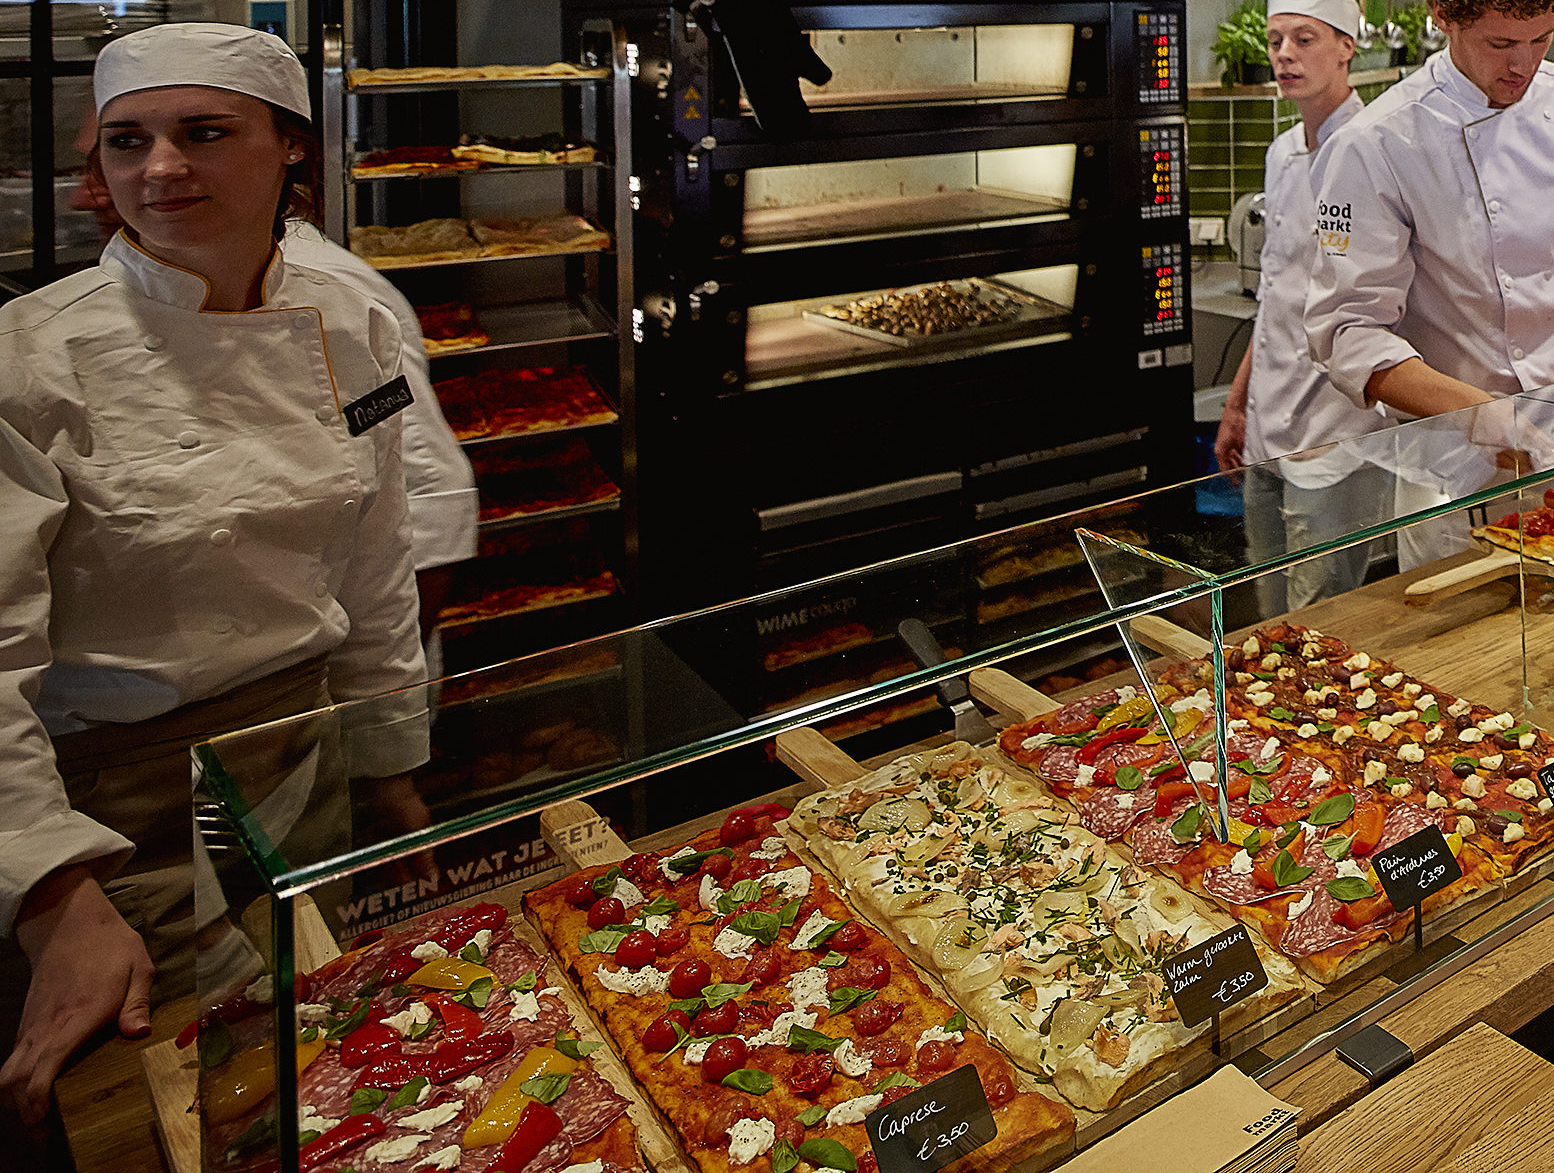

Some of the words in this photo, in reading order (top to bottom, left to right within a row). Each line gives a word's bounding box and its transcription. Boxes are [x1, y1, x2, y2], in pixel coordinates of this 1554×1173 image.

[1317, 219, 1352, 233] arkt
[336, 868, 440, 924] WETEN
[446, 850, 508, 886] WAT
[513, 838, 546, 863] JE
[878, 1100, 946, 1142] Caprese
[1242, 1108, 1284, 1134] Food
[1252, 1109, 1290, 1136] markt
